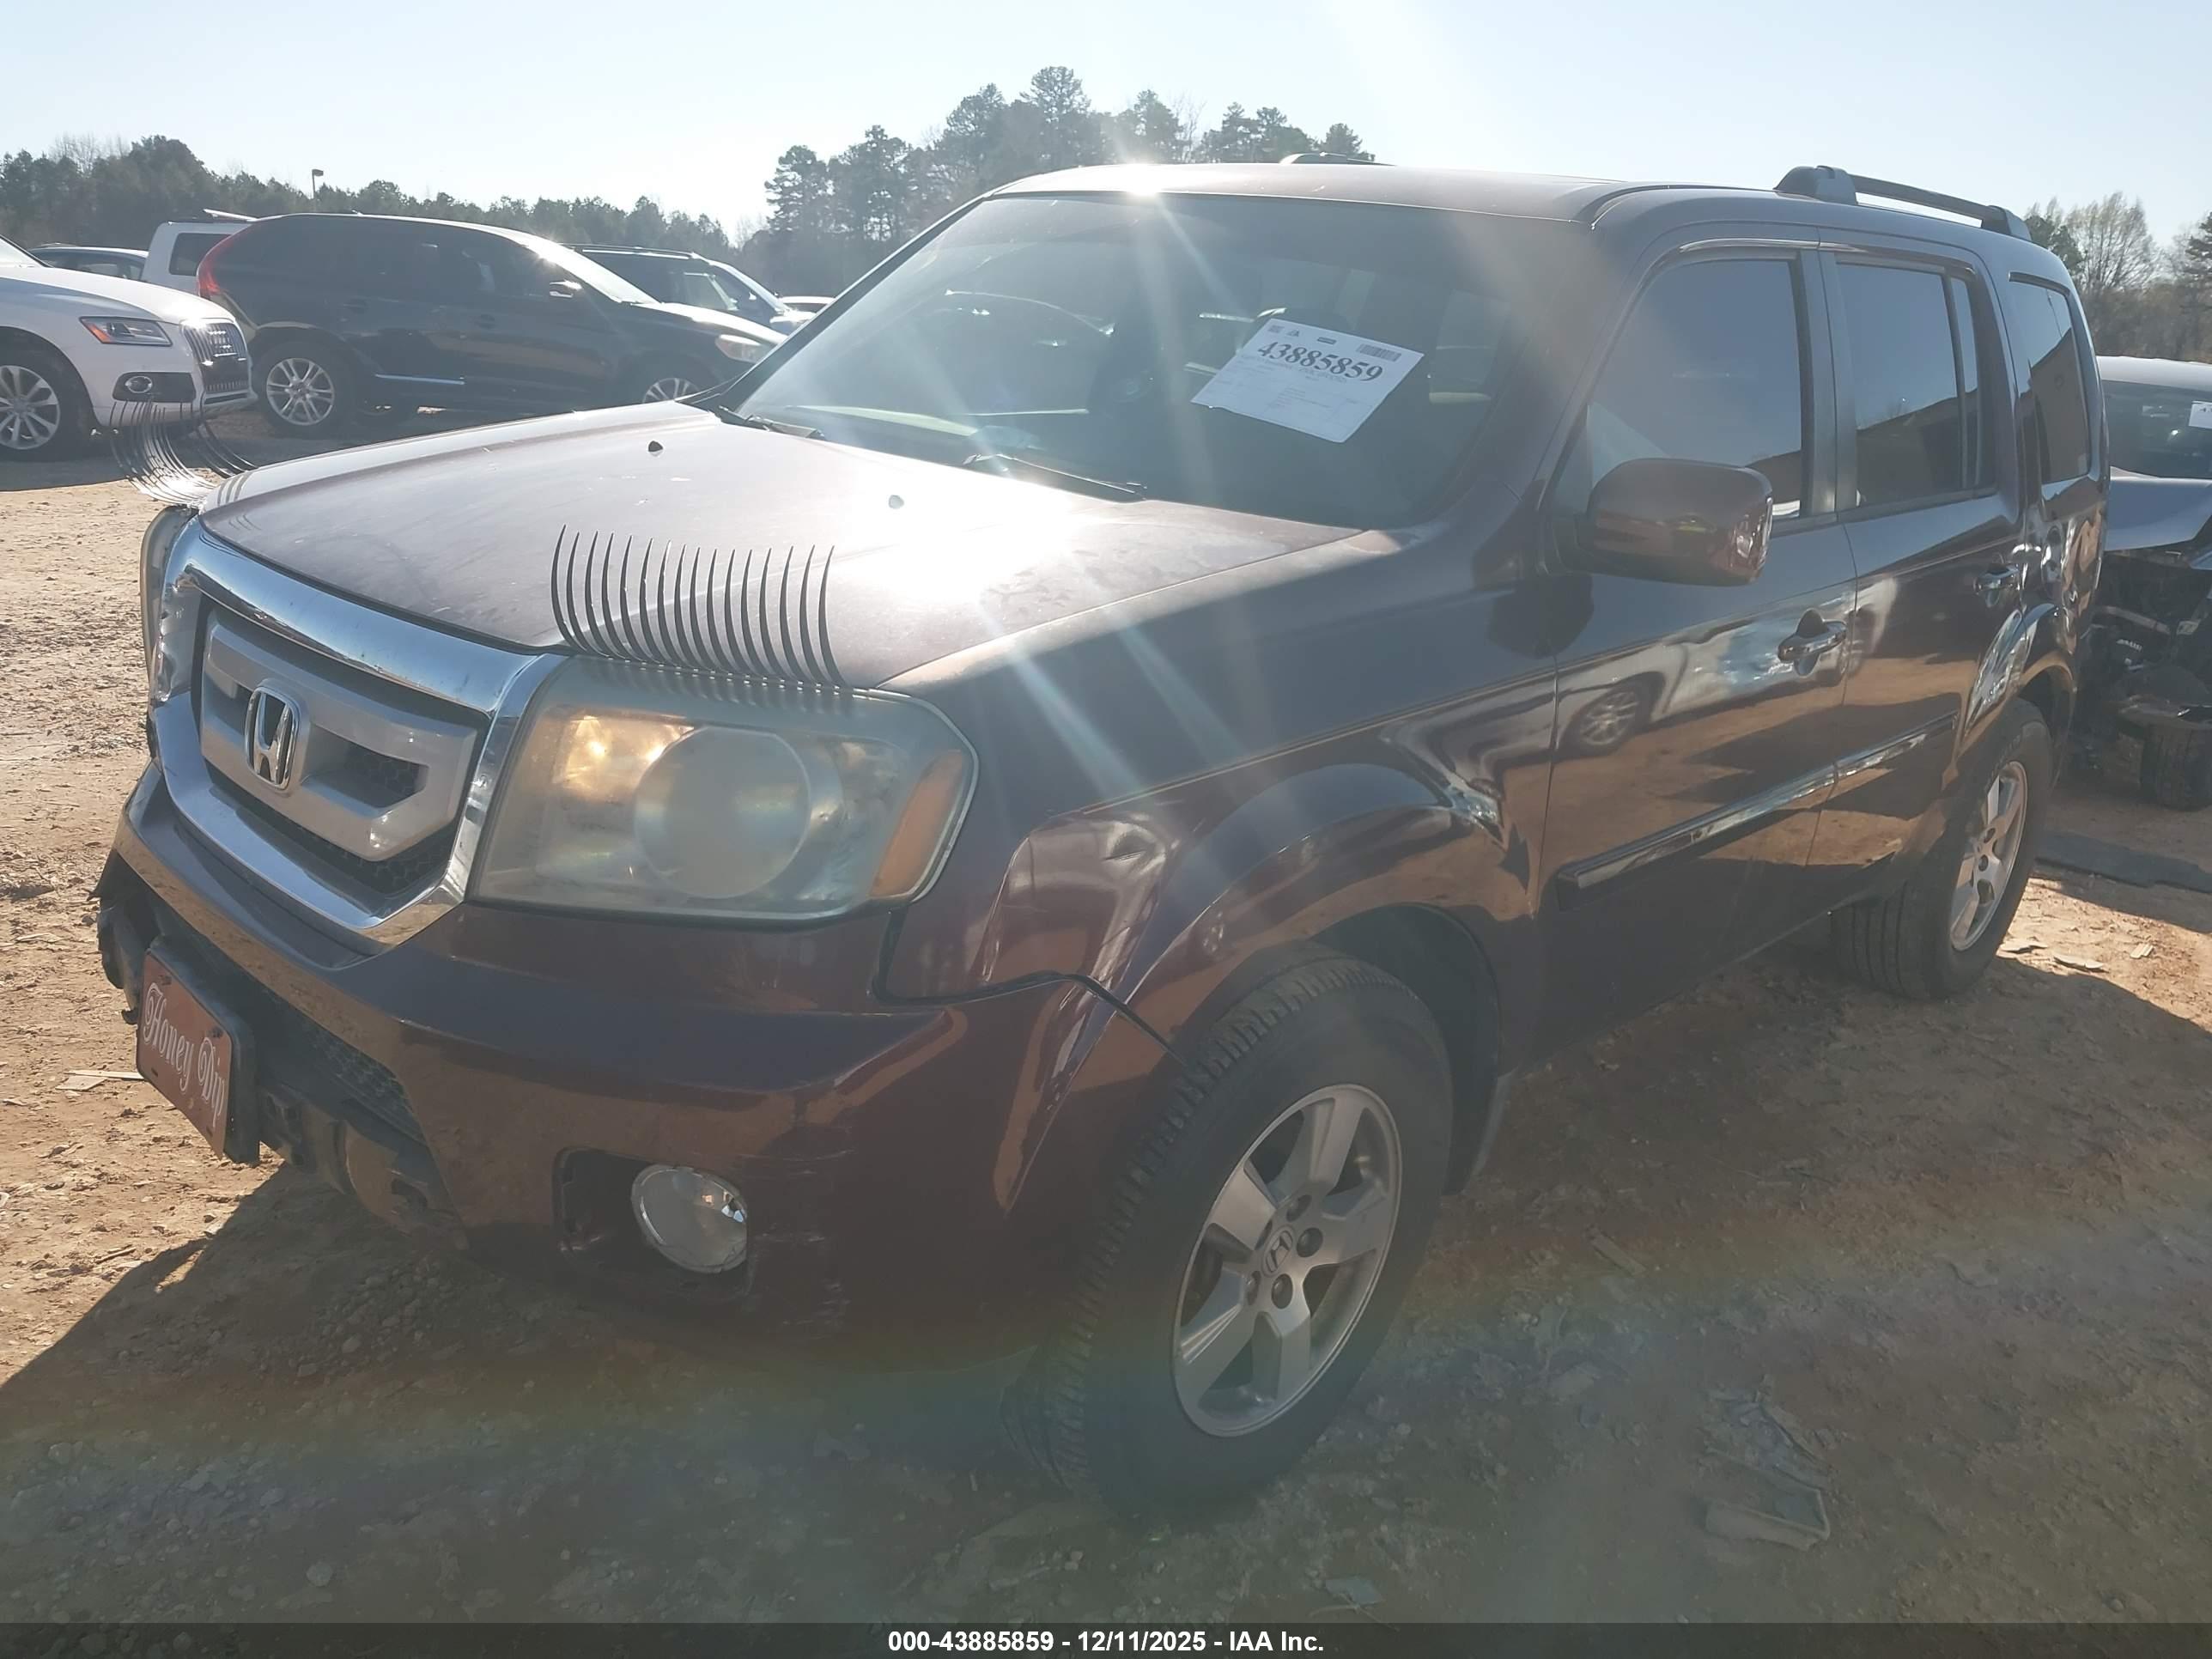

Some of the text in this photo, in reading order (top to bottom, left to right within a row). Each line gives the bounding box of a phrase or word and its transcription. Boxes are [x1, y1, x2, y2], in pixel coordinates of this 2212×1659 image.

[1257, 341, 1383, 382] 43885859
[143, 982, 225, 1127] Honey Dip
